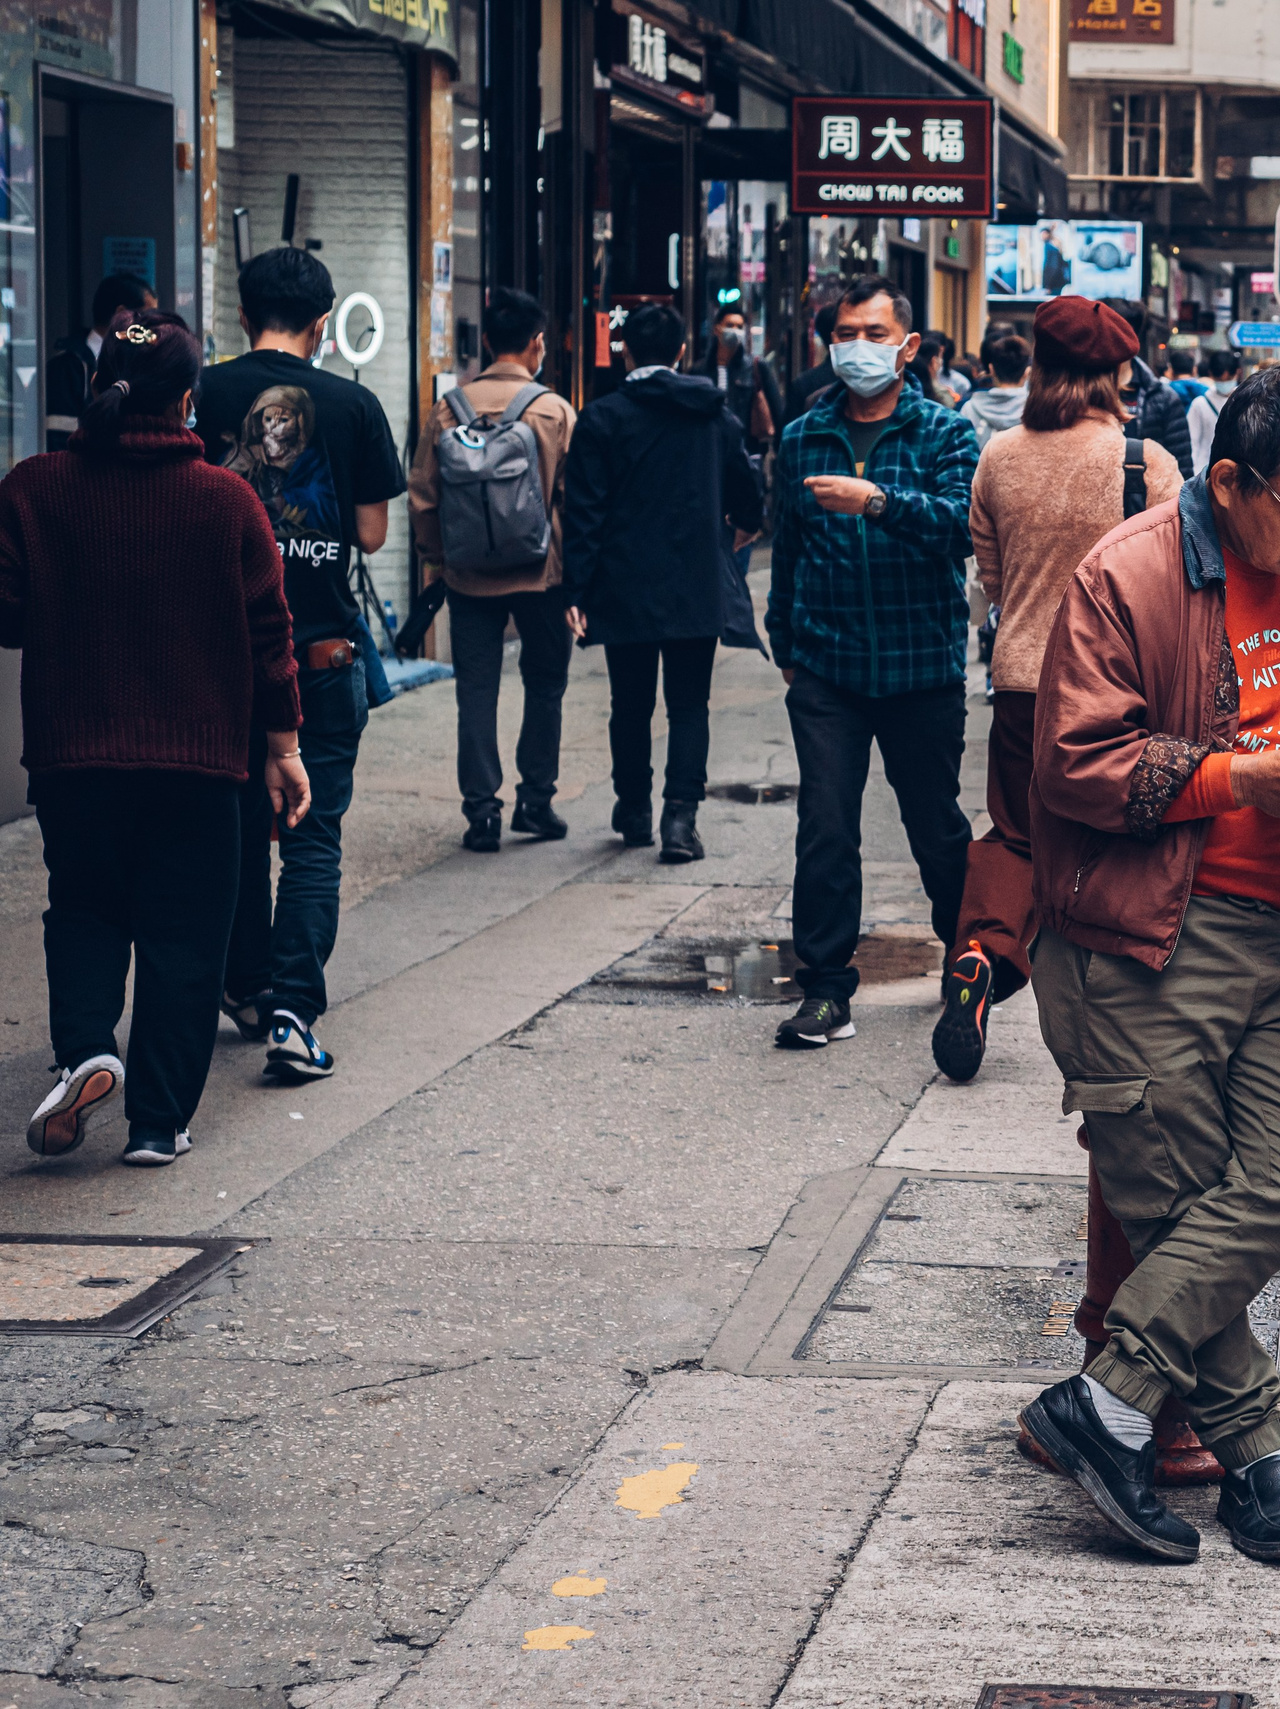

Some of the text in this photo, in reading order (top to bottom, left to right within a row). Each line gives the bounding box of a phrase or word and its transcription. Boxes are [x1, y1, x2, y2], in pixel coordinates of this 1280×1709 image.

[818, 116, 965, 163] 周大福
[818, 184, 964, 203] CHOW TAI FOOK
[1237, 632, 1261, 656] THE
